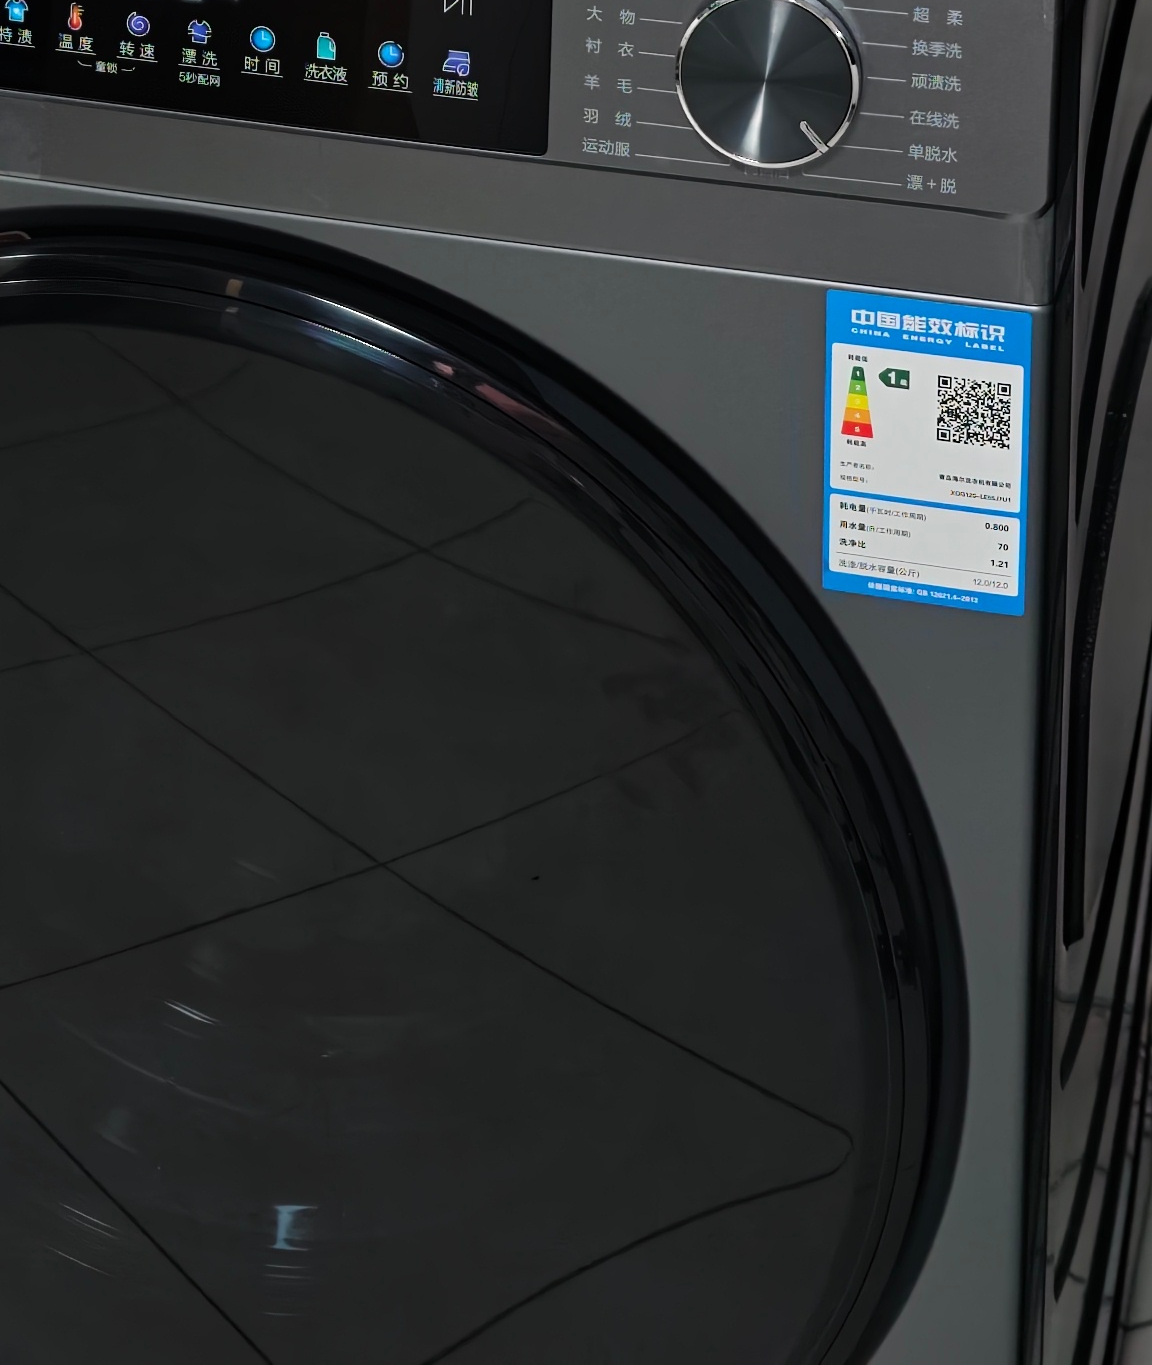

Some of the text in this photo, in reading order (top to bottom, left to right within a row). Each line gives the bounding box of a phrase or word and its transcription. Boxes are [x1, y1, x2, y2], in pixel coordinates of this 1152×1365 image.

[586, 5, 635, 25] 大物
[913, 6, 963, 26] 超柔
[58, 32, 94, 52] 温度
[119, 40, 155, 59] 转速
[585, 37, 635, 58] 衬衣
[912, 39, 962, 59] 换季洗
[95, 60, 118, 74] 童锁
[181, 47, 218, 67] 漂洗
[244, 56, 280, 75] 时间
[179, 71, 221, 87] 5秒配网
[305, 62, 347, 83] 洗衣液
[371, 70, 409, 90] 预约
[911, 73, 961, 92] 顽渍洗
[432, 78, 479, 98] 清新防皱
[584, 74, 633, 94] 羊毛
[583, 108, 632, 128] 羽绒
[909, 110, 960, 129] 在线洗
[582, 137, 630, 158] 运动服
[908, 144, 958, 163] 单脱水
[851, 309, 1005, 343] 中国能效标识
[851, 328, 1005, 352] CHINA ENERGY LABEL
[985, 522, 1009, 532] 0.800
[839, 538, 866, 548] 洗净比
[998, 542, 1009, 551] 70
[990, 559, 1008, 568] 1.21
[973, 578, 1008, 589] 12.0/12.0
